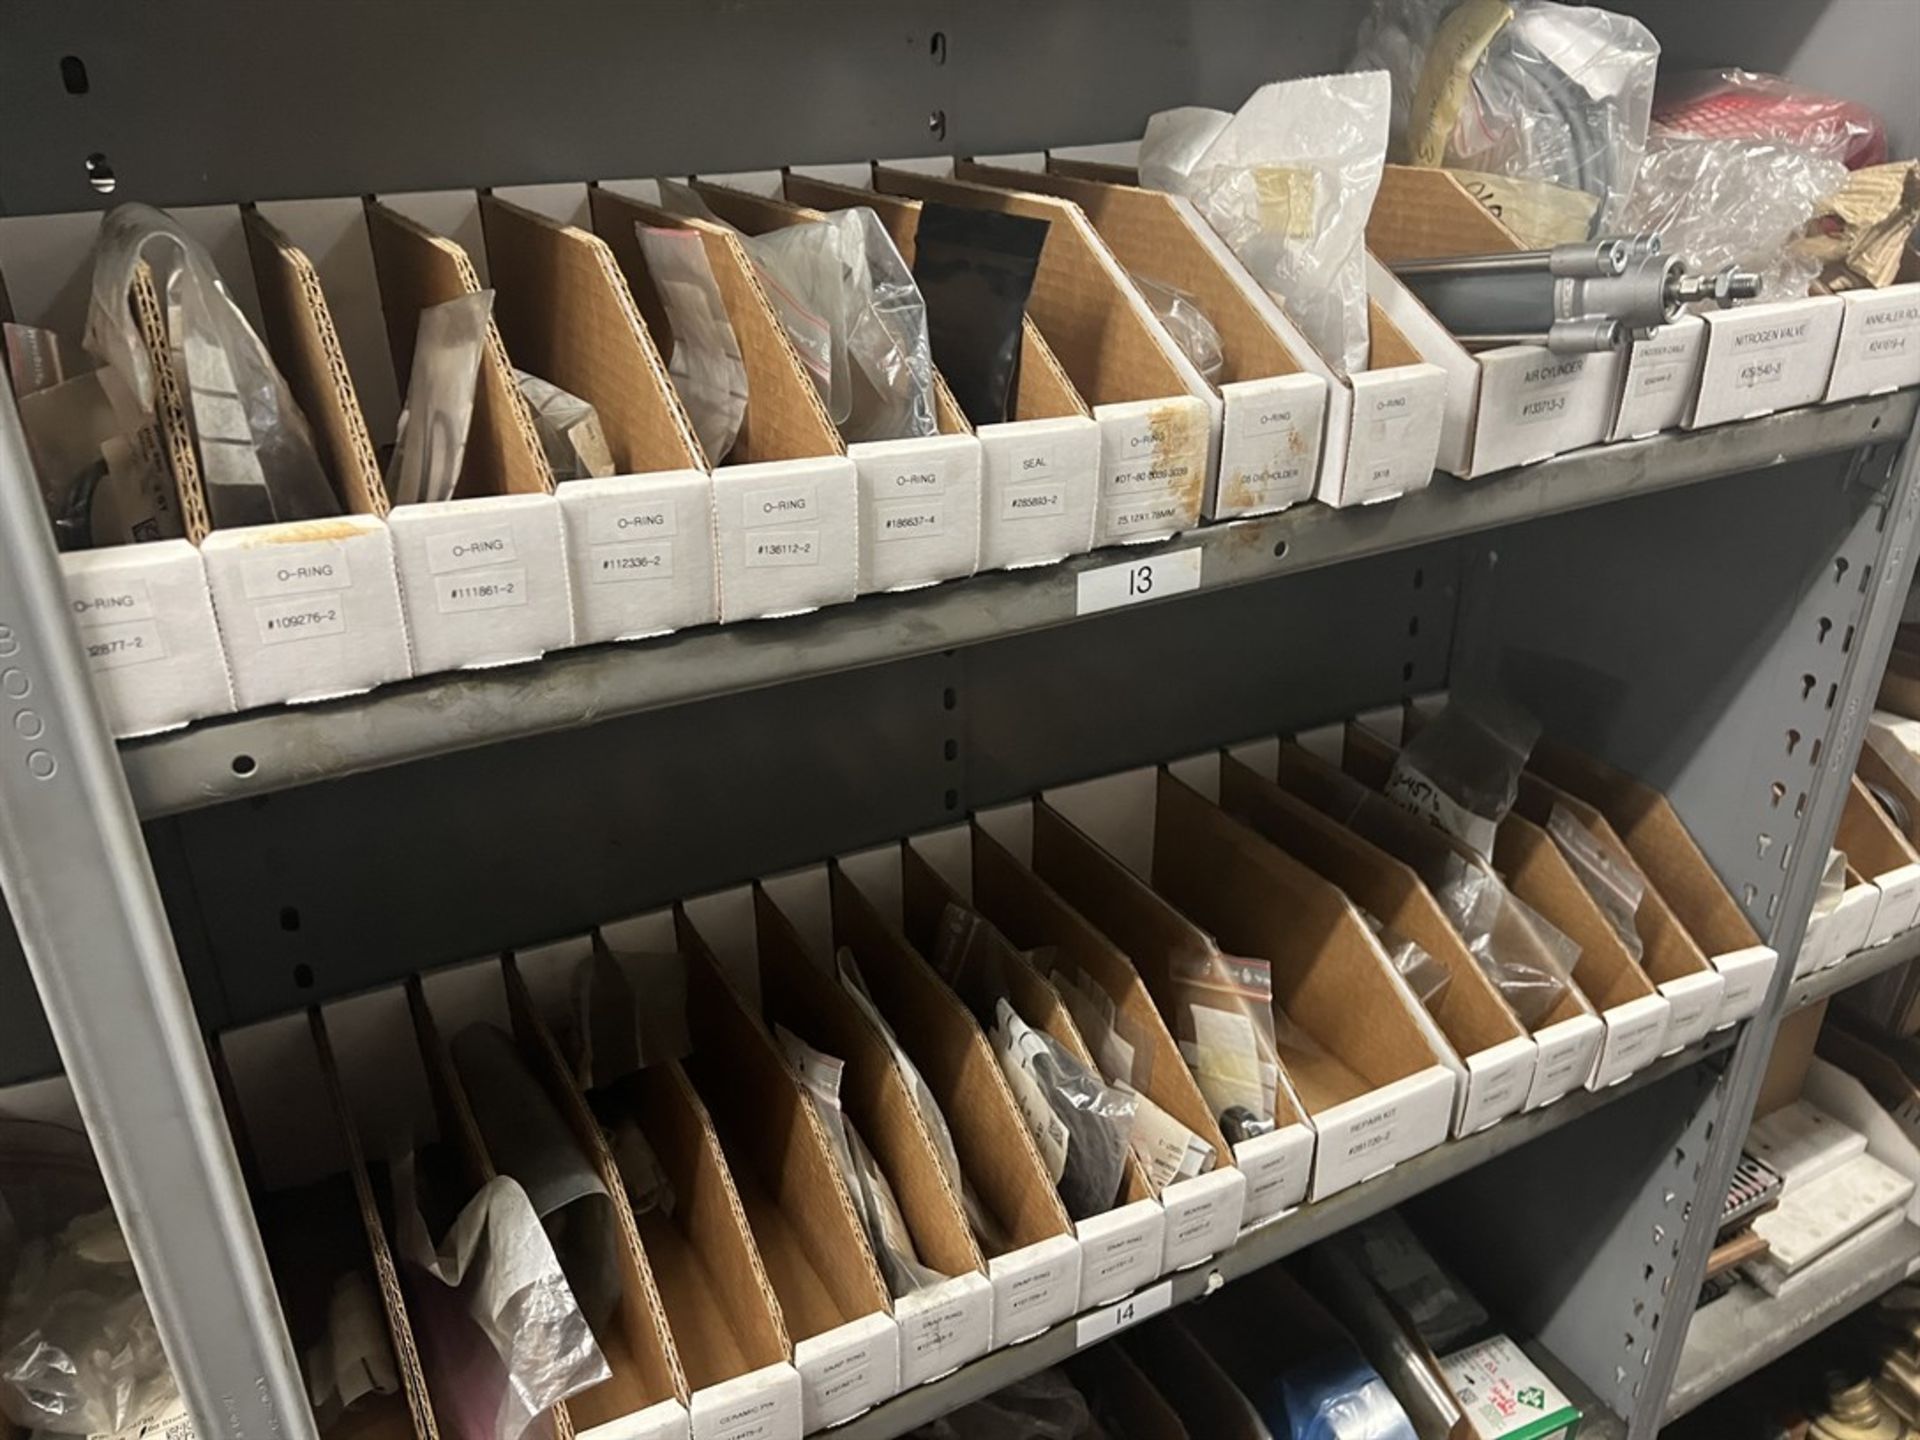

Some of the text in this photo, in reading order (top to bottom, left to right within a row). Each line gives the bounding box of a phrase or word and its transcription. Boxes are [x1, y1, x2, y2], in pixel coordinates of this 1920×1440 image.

[1735, 325, 1806, 347] NITROGEN VALVE
[1524, 361, 1583, 385] AIR CYLINDER
[1377, 397, 1406, 411] O-RING
[1261, 411, 1290, 425] O-RING
[1023, 459, 1046, 470] SEAL
[897, 473, 936, 487] O-RING
[764, 499, 806, 513] O-RING
[618, 514, 665, 530] O-RING
[886, 516, 935, 529] #186637-4
[453, 540, 504, 558] O-RING
[758, 543, 811, 556] #136112-2
[603, 555, 661, 570] #112336-2
[278, 564, 333, 582] O-RING
[1129, 565, 1153, 596] 13
[452, 583, 515, 600] #111861-2
[74, 595, 134, 613] O-RING
[268, 610, 337, 630] #109276-2
[1350, 1115, 1382, 1133] REPAIR
[1116, 1303, 1135, 1326] 14
